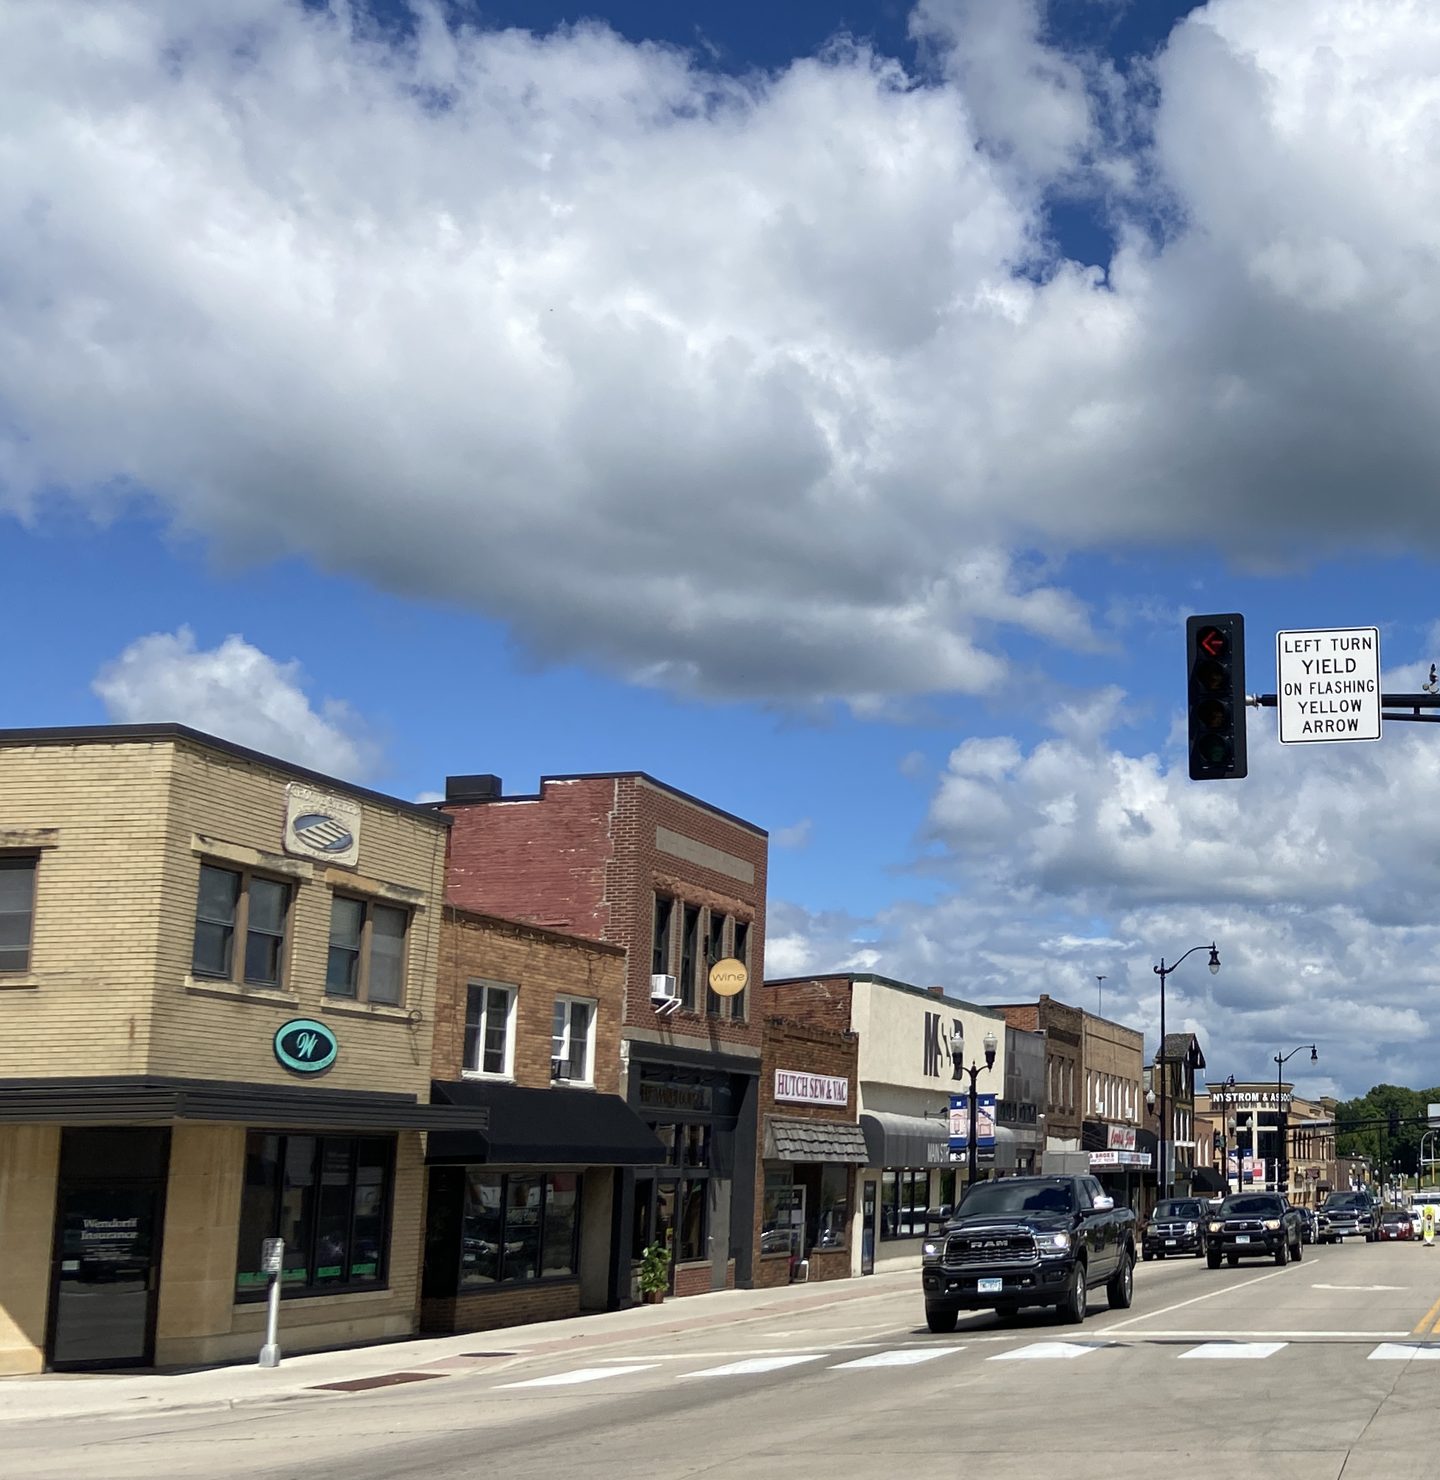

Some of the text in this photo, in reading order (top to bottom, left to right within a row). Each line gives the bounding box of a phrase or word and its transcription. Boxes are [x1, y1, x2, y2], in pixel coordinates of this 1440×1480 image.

[1284, 637, 1372, 653] LEFT TURN
[1302, 658, 1357, 675] YIELD
[1284, 679, 1375, 696] ON FLASHING
[1298, 699, 1362, 714] YELLOW
[1302, 718, 1359, 734] ARROW
[712, 972, 745, 982] wine
[777, 1073, 847, 1102] HUTCH SEW & VAC
[1213, 1092, 1259, 1102] NYSTROM
[1262, 1092, 1268, 1102] &
[83, 1217, 139, 1228] Wendorff
[80, 1230, 139, 1240] Insurance
[970, 1240, 1009, 1249] RAM
